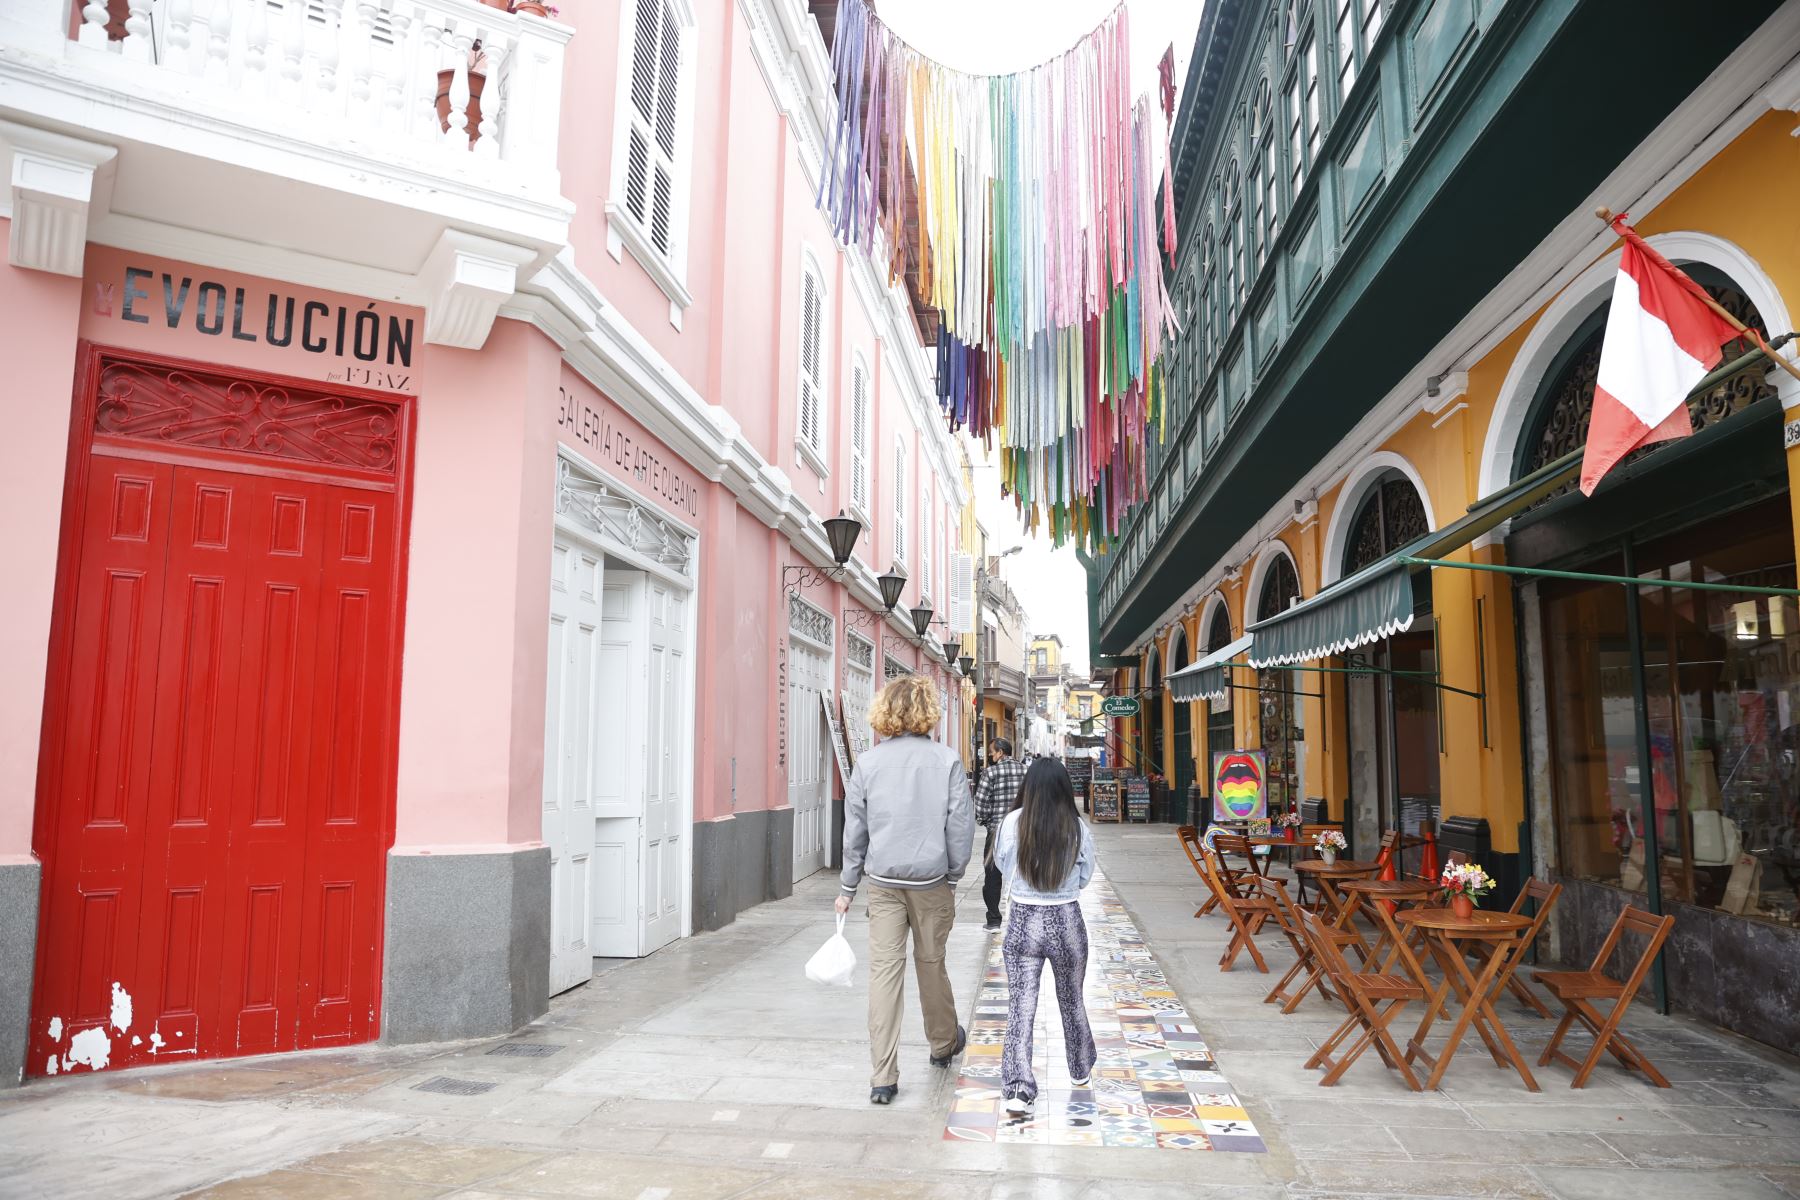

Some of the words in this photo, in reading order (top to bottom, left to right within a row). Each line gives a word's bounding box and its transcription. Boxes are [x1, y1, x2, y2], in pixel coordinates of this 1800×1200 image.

[326, 371, 343, 382] por
[615, 431, 631, 472] DE
[632, 445, 660, 492] ARTE
[661, 466, 697, 517] CUBANO
[1105, 703, 1136, 712] Comedor
